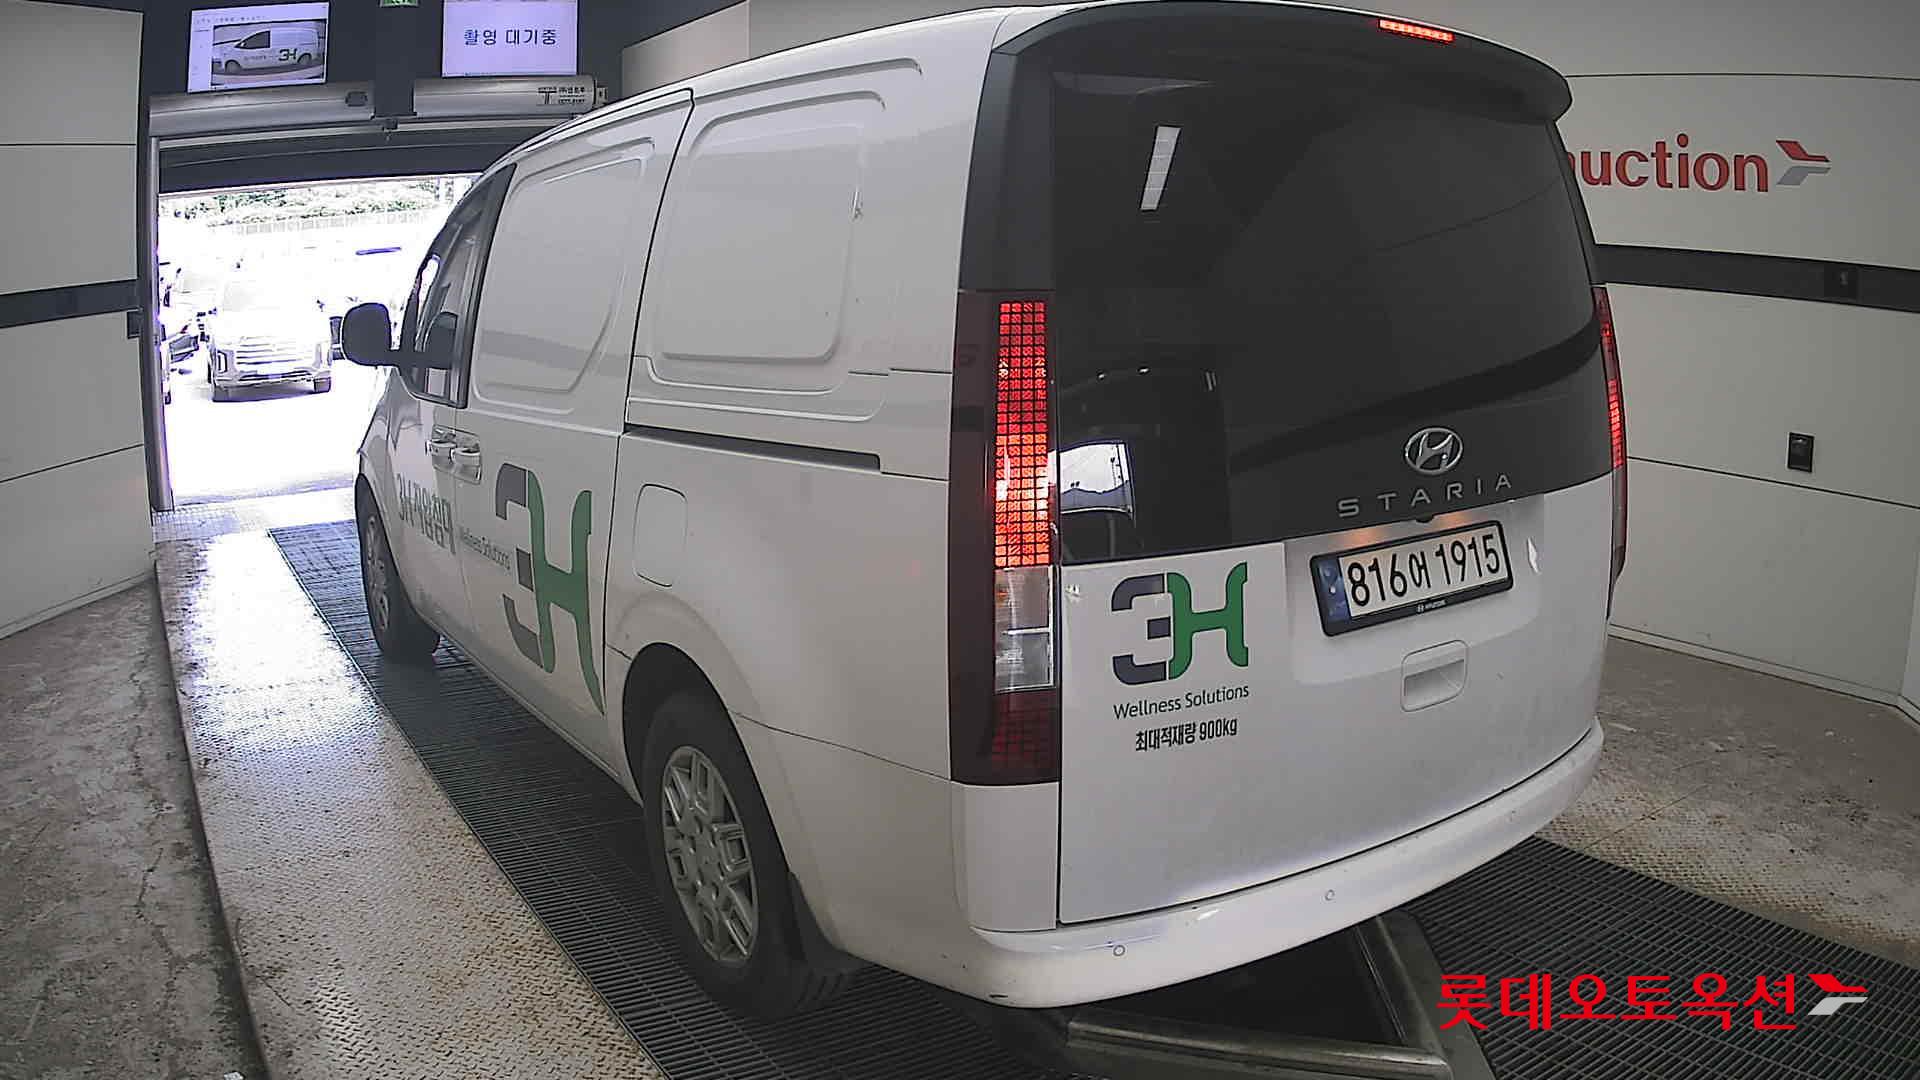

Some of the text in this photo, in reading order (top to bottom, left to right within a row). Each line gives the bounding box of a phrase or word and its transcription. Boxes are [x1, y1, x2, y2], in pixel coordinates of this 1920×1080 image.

[464, 29, 556, 46] 촬영 대기중
[1338, 474, 1511, 517] STARIA
[1347, 534, 1500, 607] 816어 1915
[1111, 562, 1249, 686] 3H
[1113, 685, 1249, 720] Wellness Solutions
[1135, 718, 1238, 752] 최대적재량 900kg
